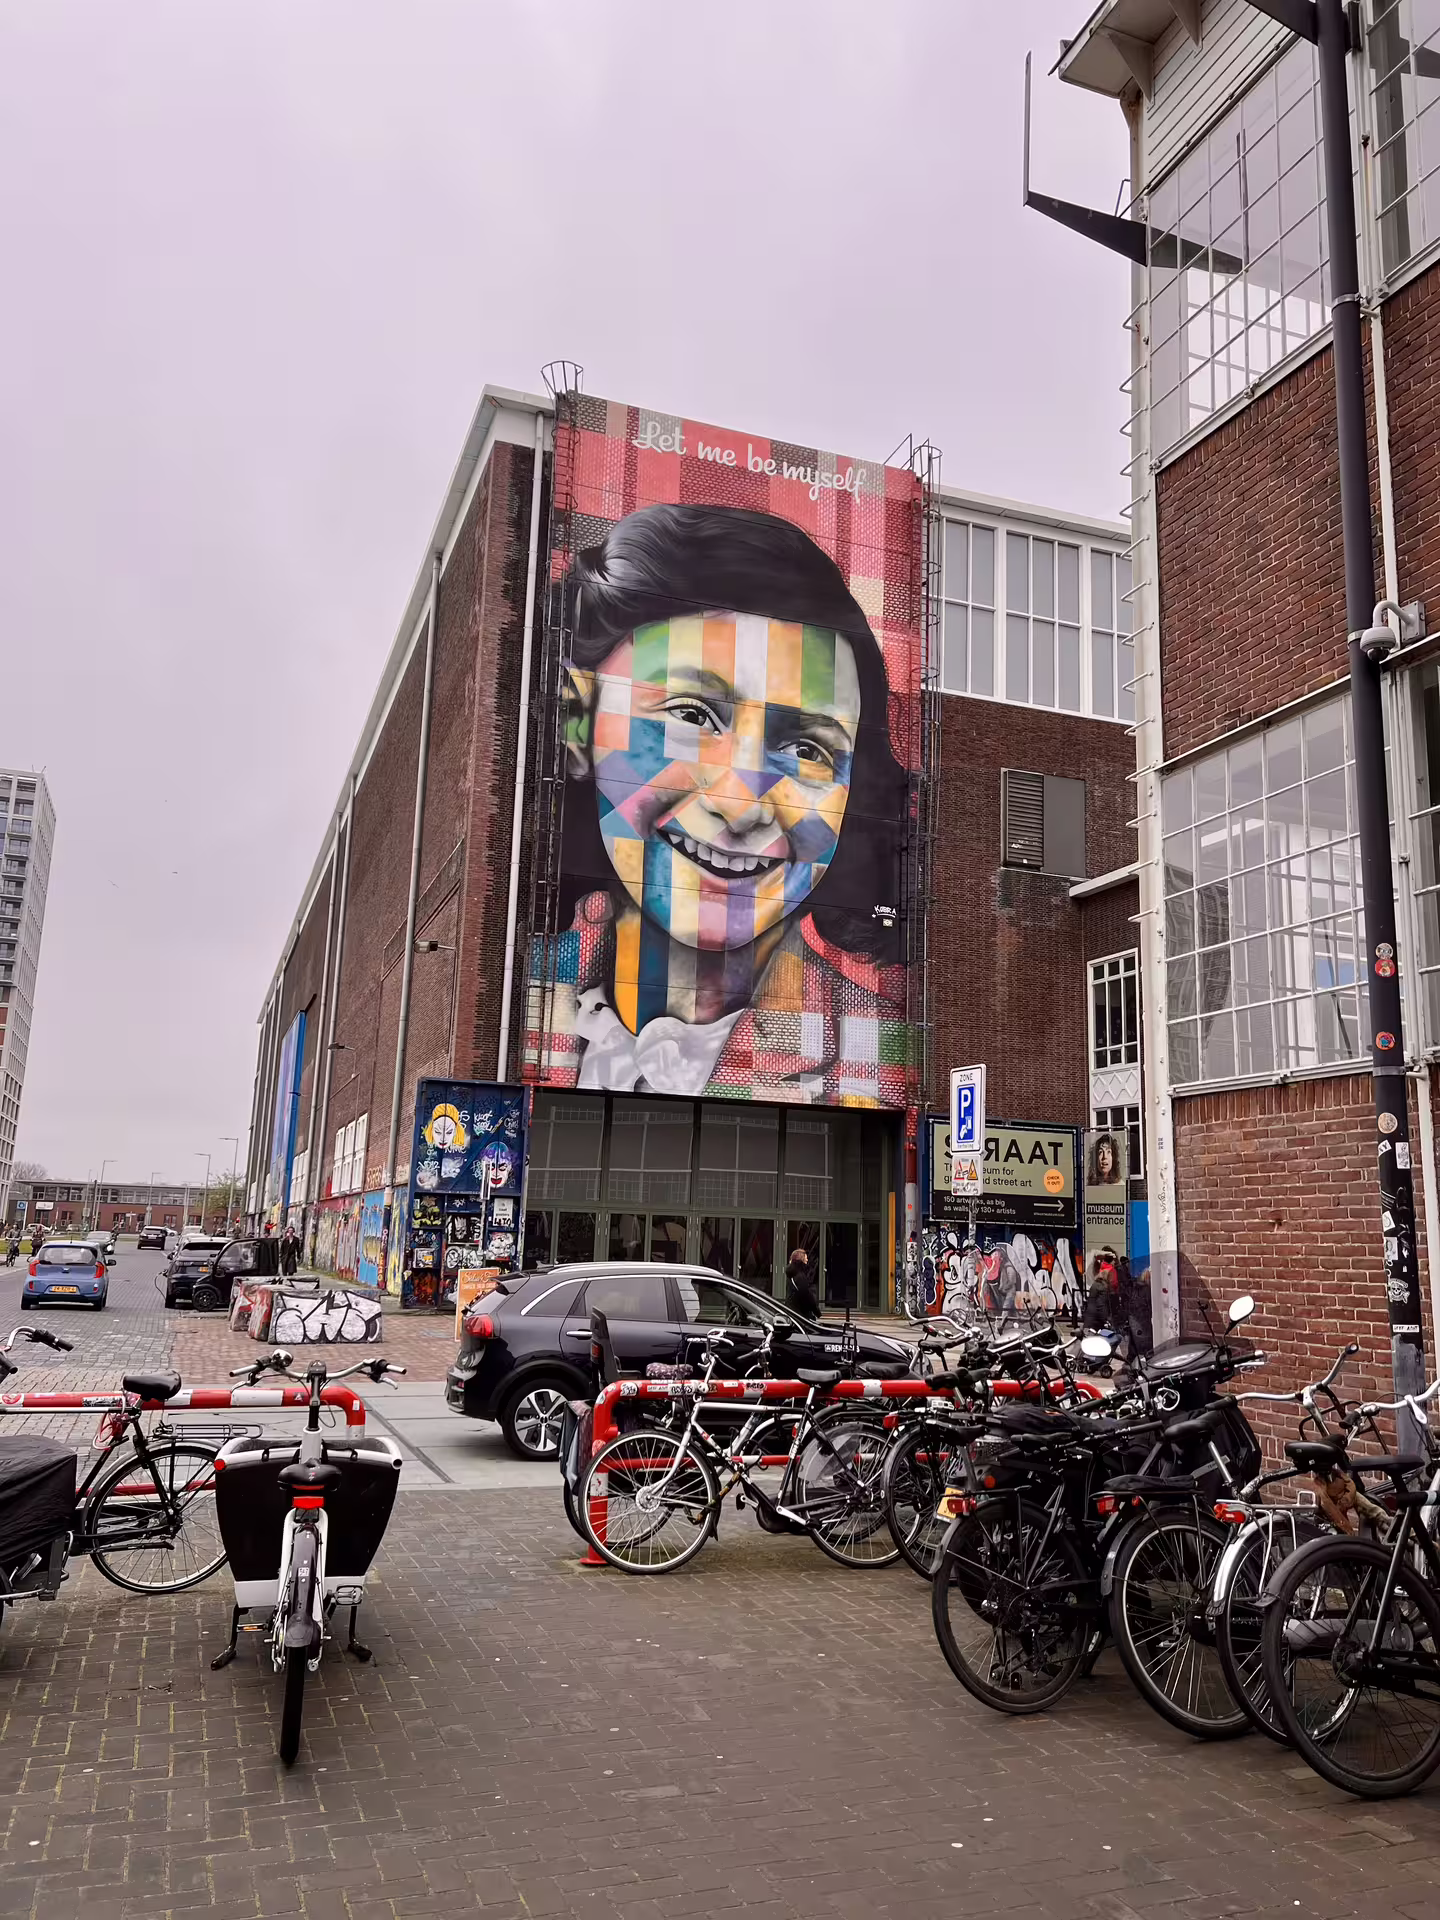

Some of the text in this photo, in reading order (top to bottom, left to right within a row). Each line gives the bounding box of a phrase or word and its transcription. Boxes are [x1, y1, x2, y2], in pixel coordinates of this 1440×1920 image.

[632, 421, 867, 504] Let me be myself
[959, 1073, 974, 1083] ZONE
[961, 1089, 971, 1118] P
[1002, 1167, 1015, 1176] for
[992, 1177, 1018, 1186] street
[1020, 1179, 1032, 1187] art
[995, 1199, 1006, 1207] big
[1087, 1205, 1123, 1213] museum
[1086, 1215, 1125, 1226] entrance
